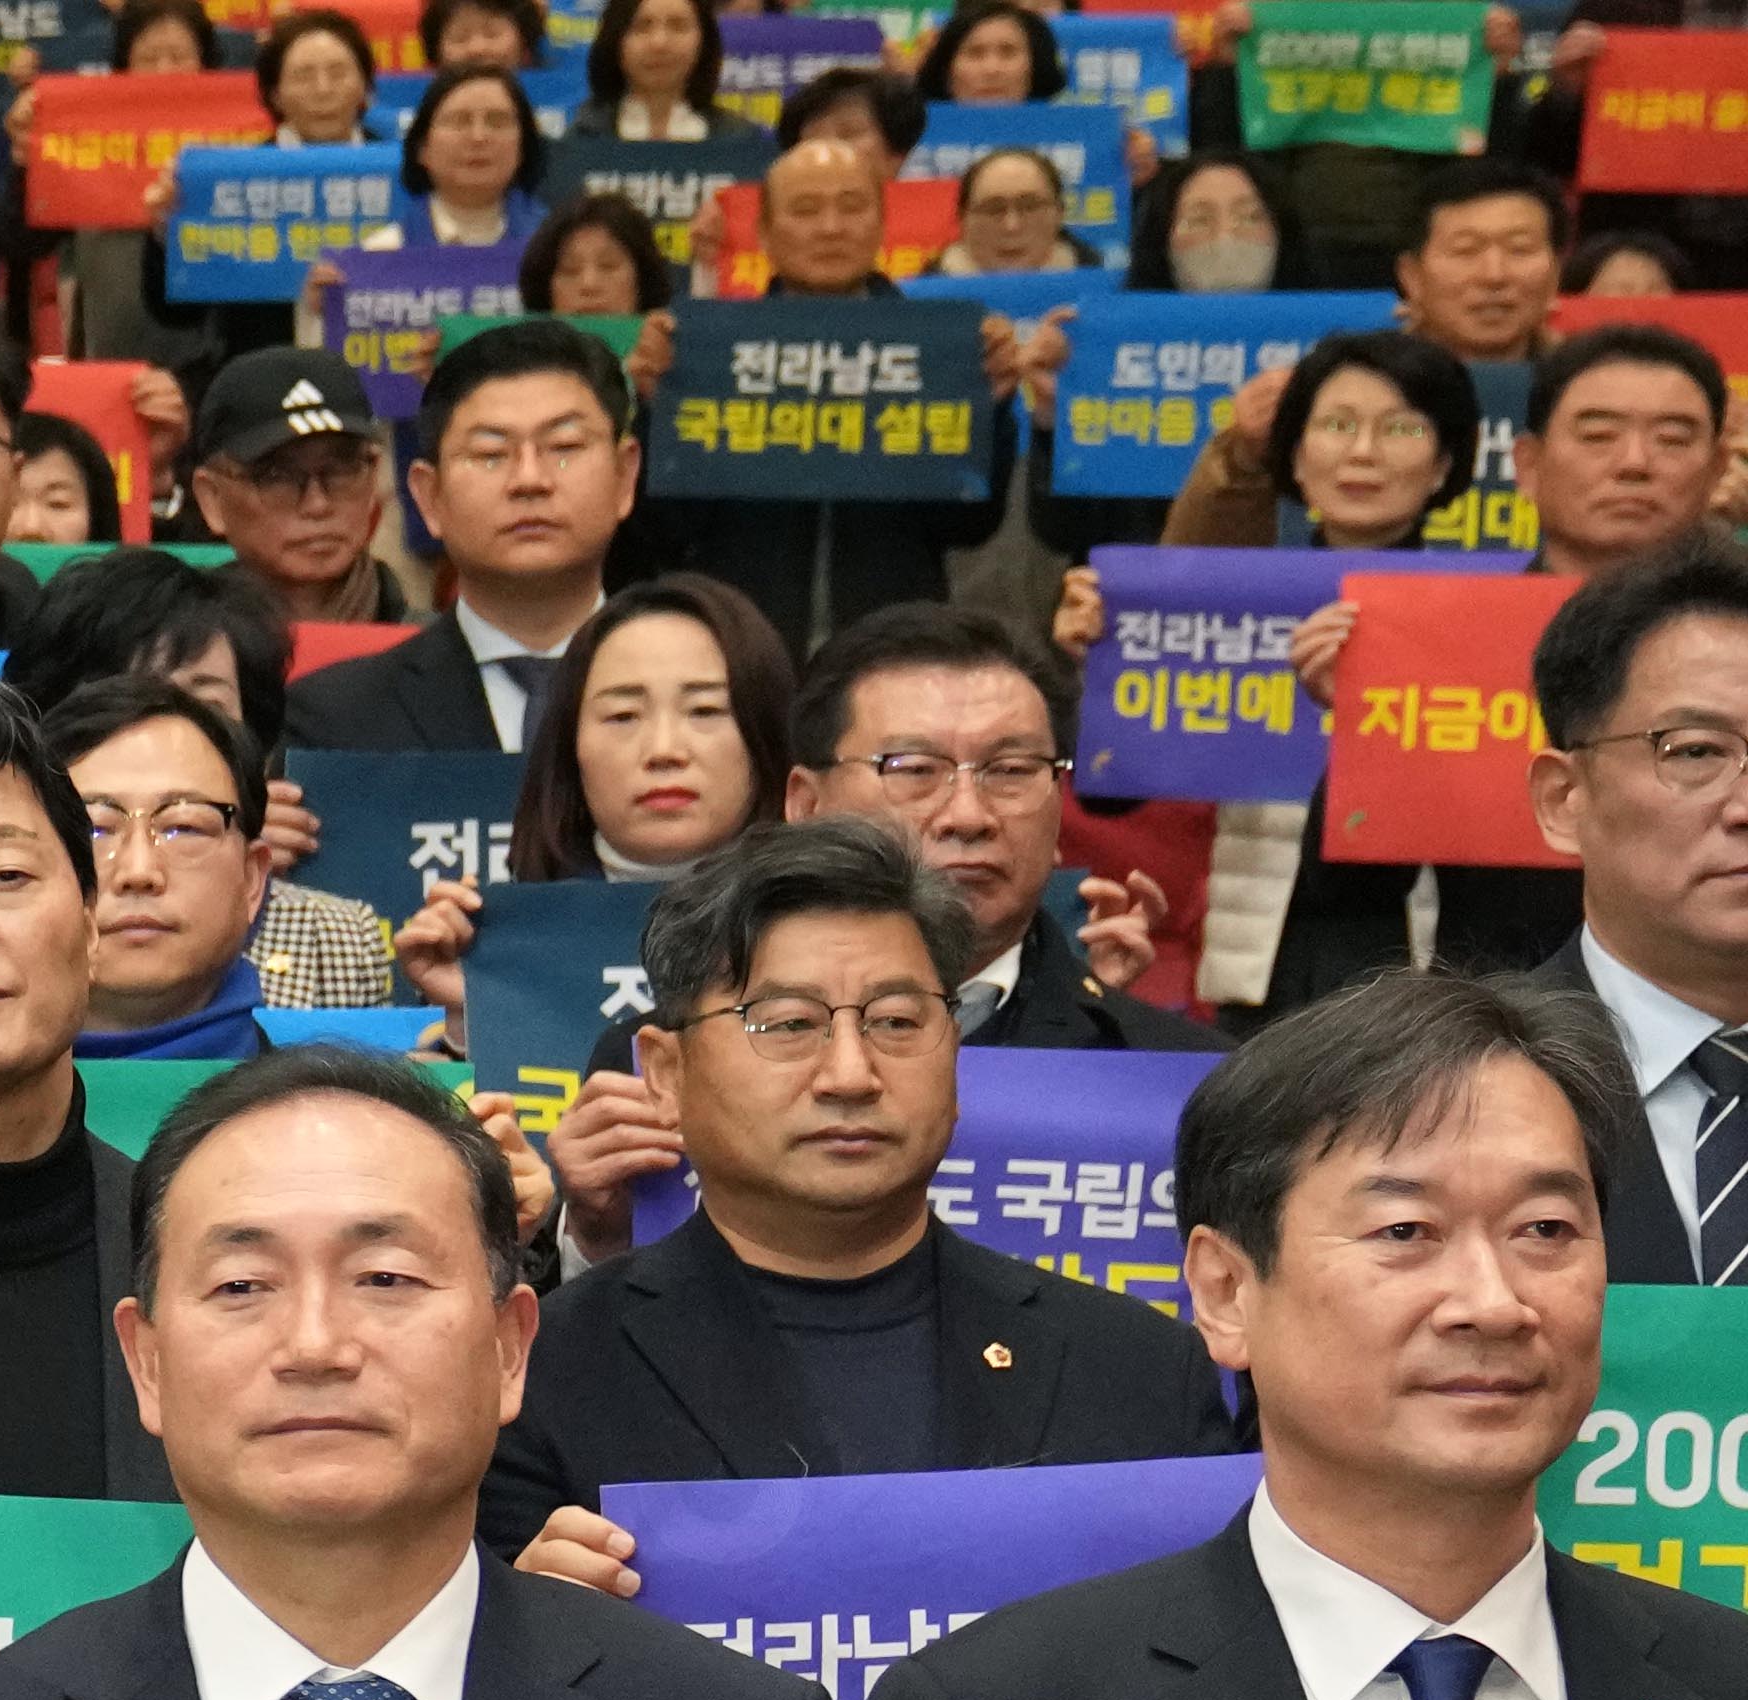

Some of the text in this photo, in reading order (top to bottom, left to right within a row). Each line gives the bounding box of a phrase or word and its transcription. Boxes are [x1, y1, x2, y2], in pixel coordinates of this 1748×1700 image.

[212, 176, 391, 218] 도민의 염원
[343, 330, 424, 373] 이번
[732, 342, 921, 396] 전라남도
[1112, 342, 1246, 390] 도민의
[675, 400, 971, 454] 국립의대 설립
[1070, 399, 1196, 445] 한마음
[1422, 490, 1539, 551] 의대
[1114, 668, 1296, 734] 이번에
[1358, 684, 1546, 753] 지금이
